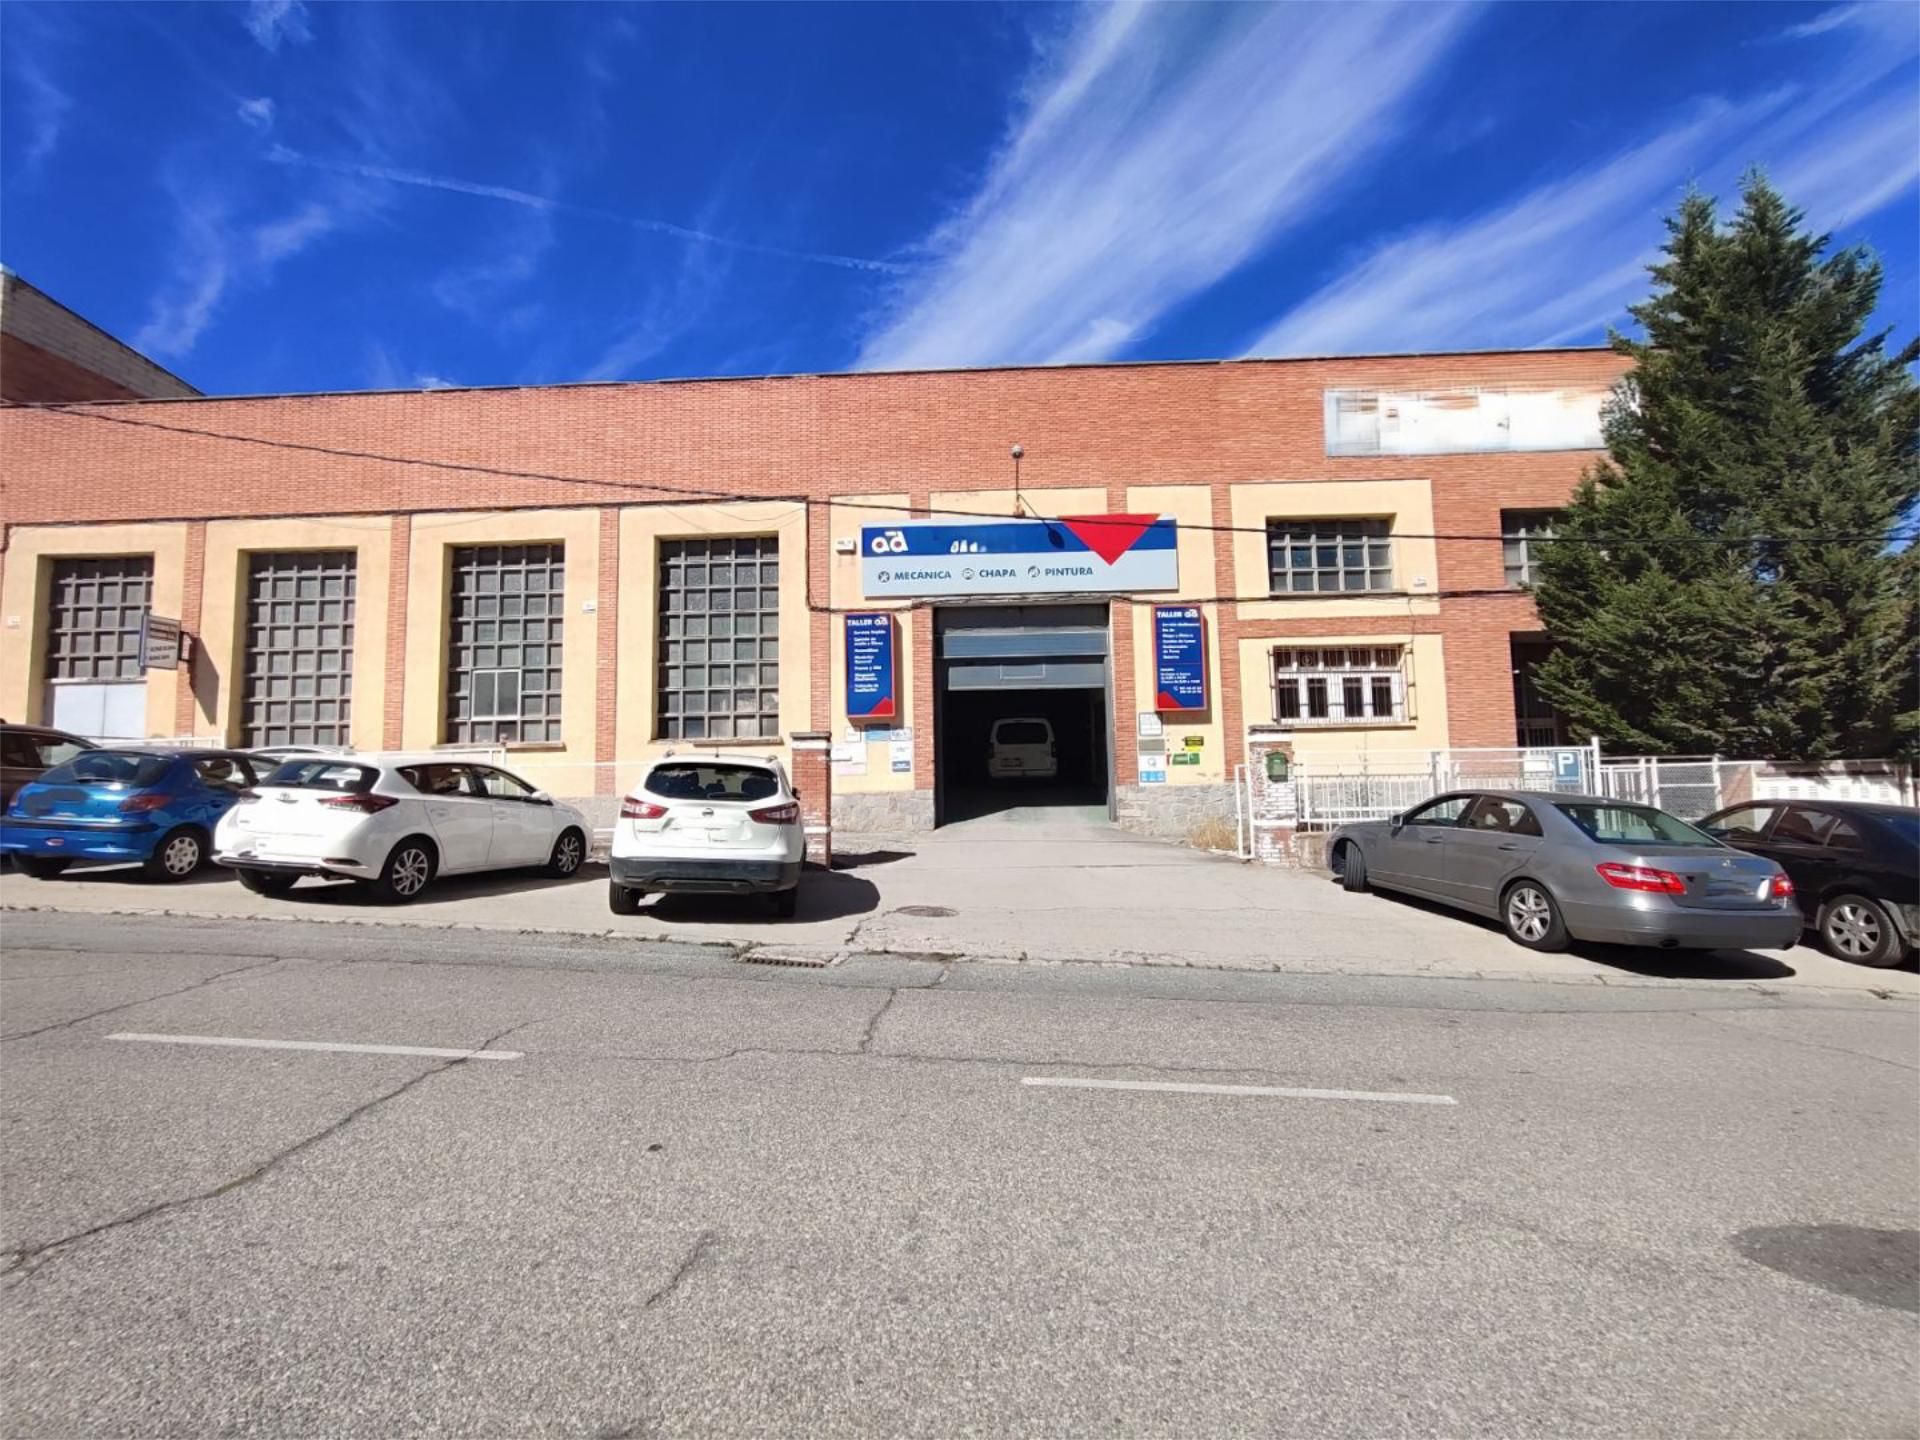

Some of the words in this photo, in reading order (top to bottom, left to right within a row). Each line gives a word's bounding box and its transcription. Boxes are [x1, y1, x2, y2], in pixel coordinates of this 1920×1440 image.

[979, 568, 1016, 578] CHAPA
[1044, 567, 1094, 577] PINTURA
[1558, 752, 1574, 775] P
